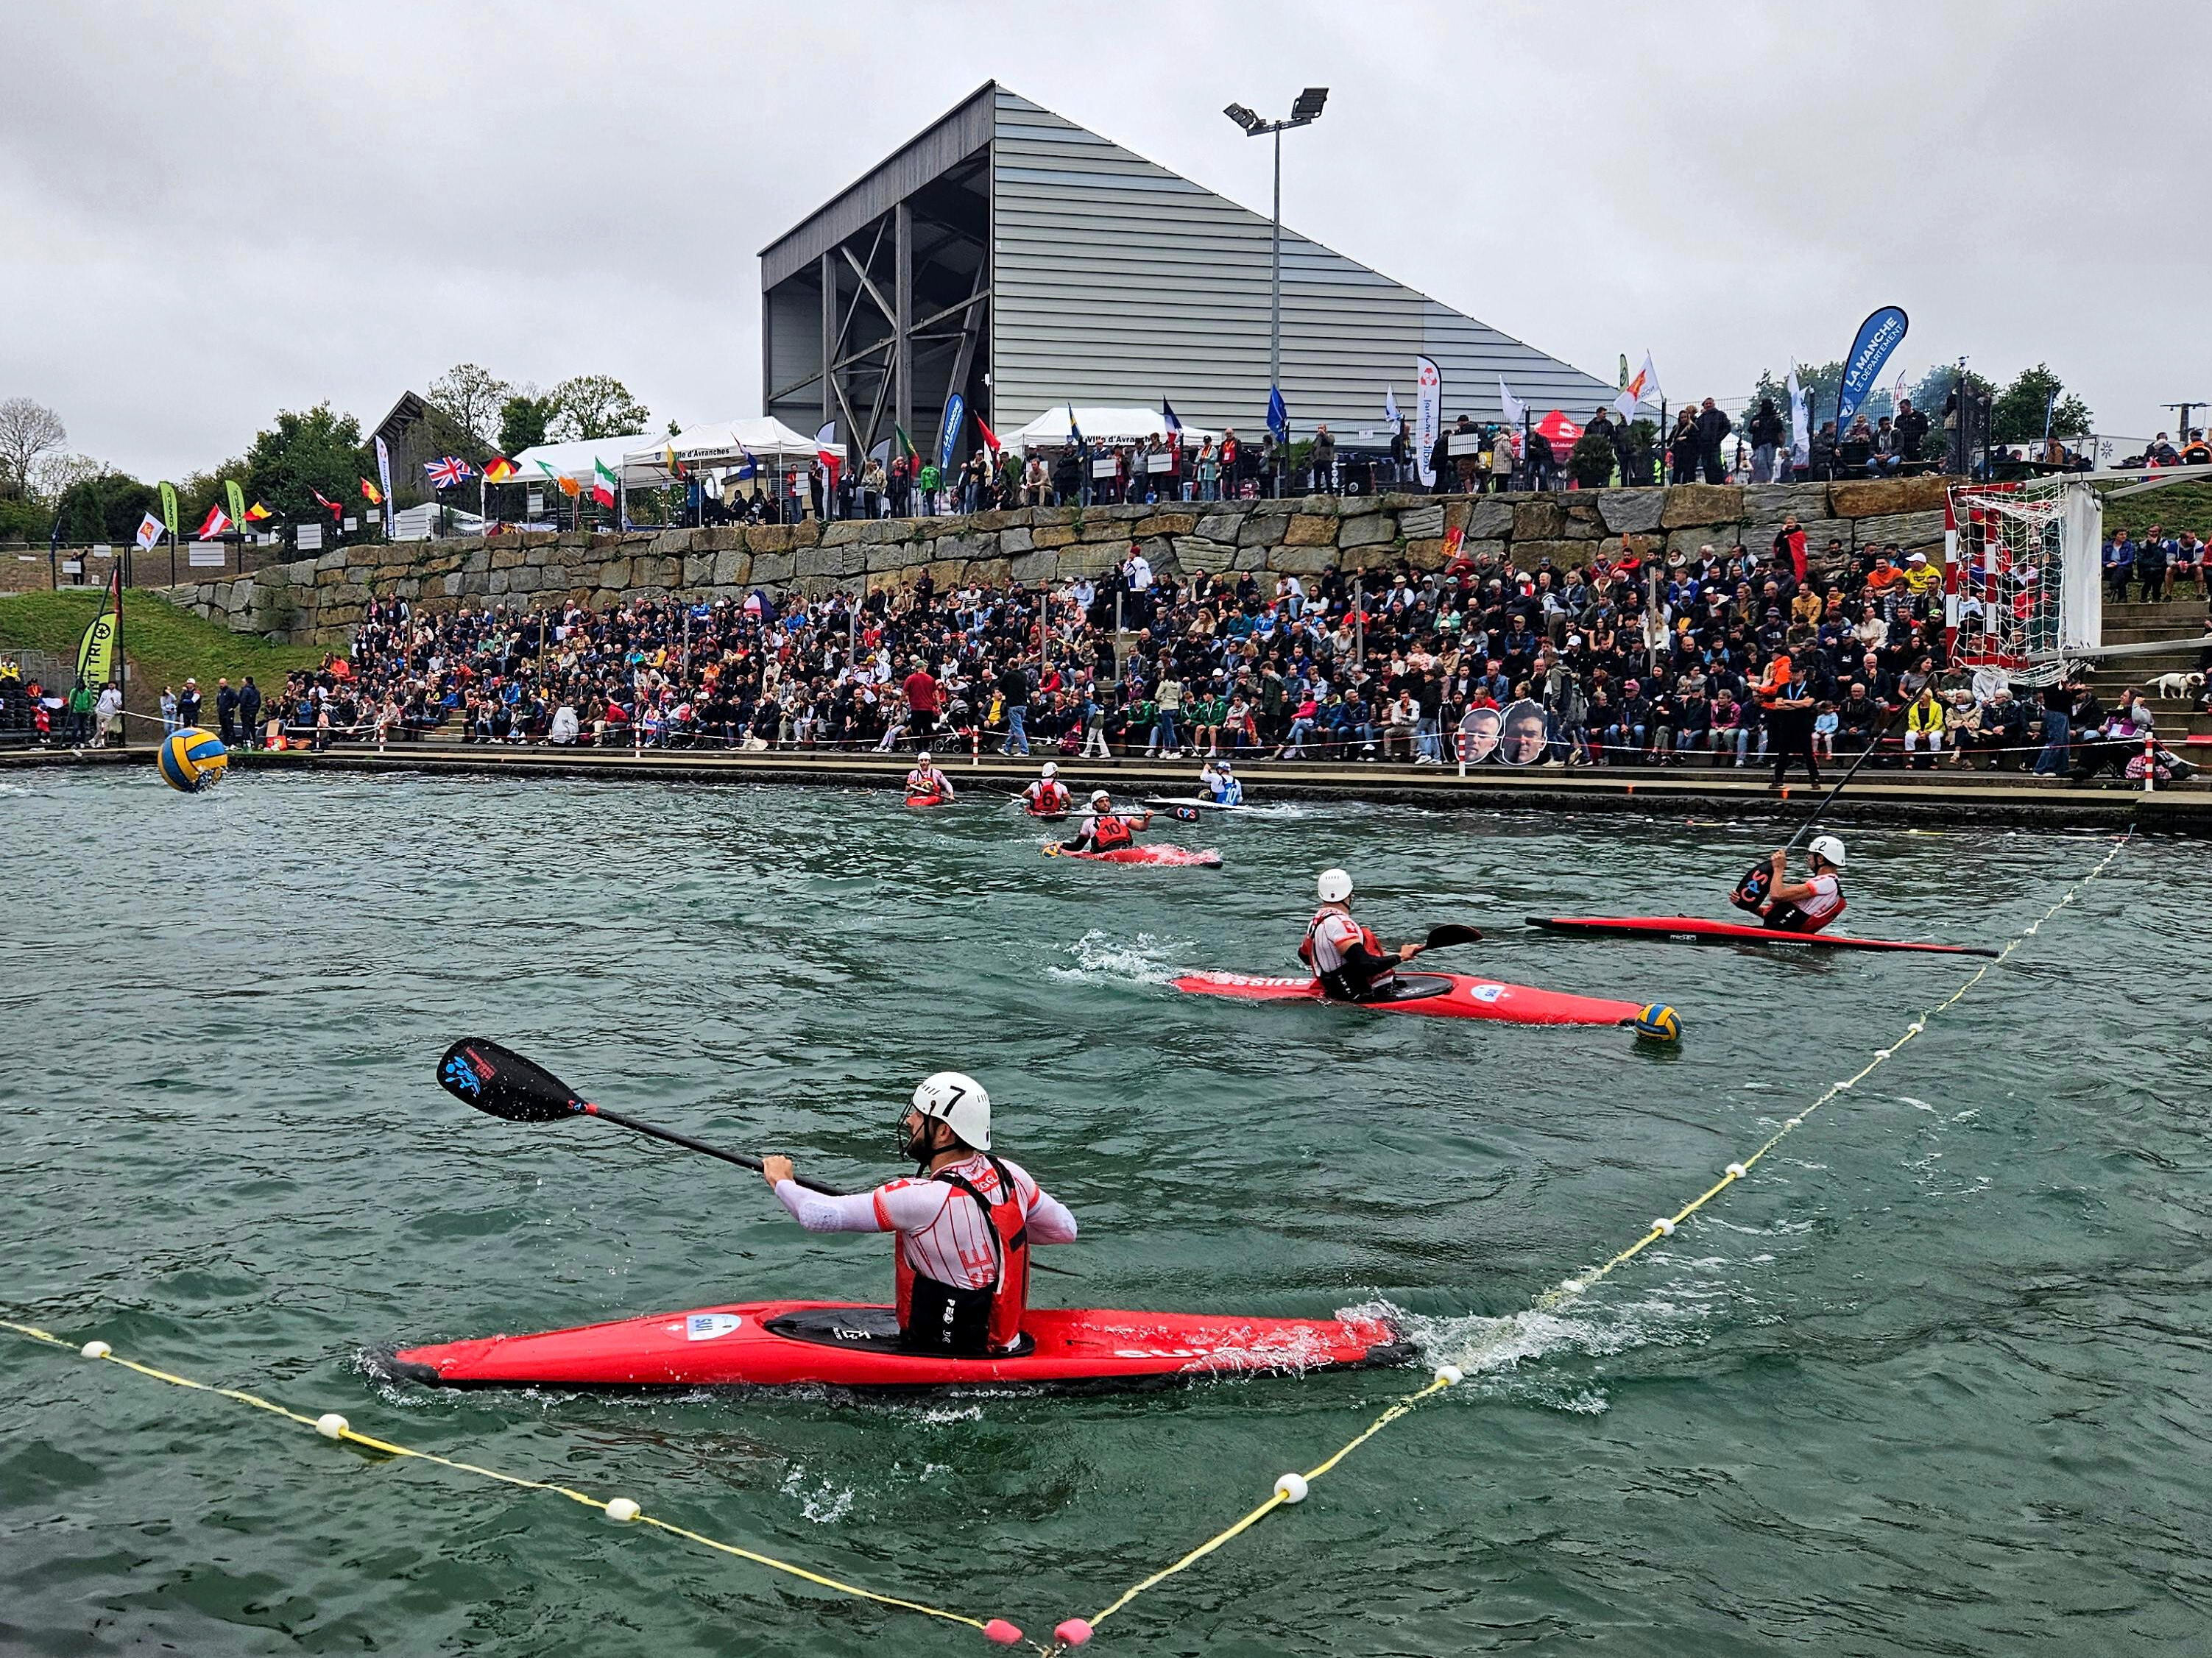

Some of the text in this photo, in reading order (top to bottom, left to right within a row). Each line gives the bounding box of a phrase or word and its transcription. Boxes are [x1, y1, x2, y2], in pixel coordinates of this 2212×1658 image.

[1845, 316, 1897, 387] LA MANCHE
[1854, 324, 1903, 393] LE DÉPARTEMENT
[688, 447, 729, 458] d'Avranches
[88, 642, 101, 666] TRI
[1042, 791, 1054, 807] 6
[1225, 787, 1237, 803] 10
[1177, 807, 1195, 818] CPS
[1104, 823, 1120, 835] 10
[1818, 840, 1826, 852] 2
[1742, 870, 1768, 902] CPS
[942, 1085, 967, 1118] 7
[695, 1318, 713, 1331] SUI
